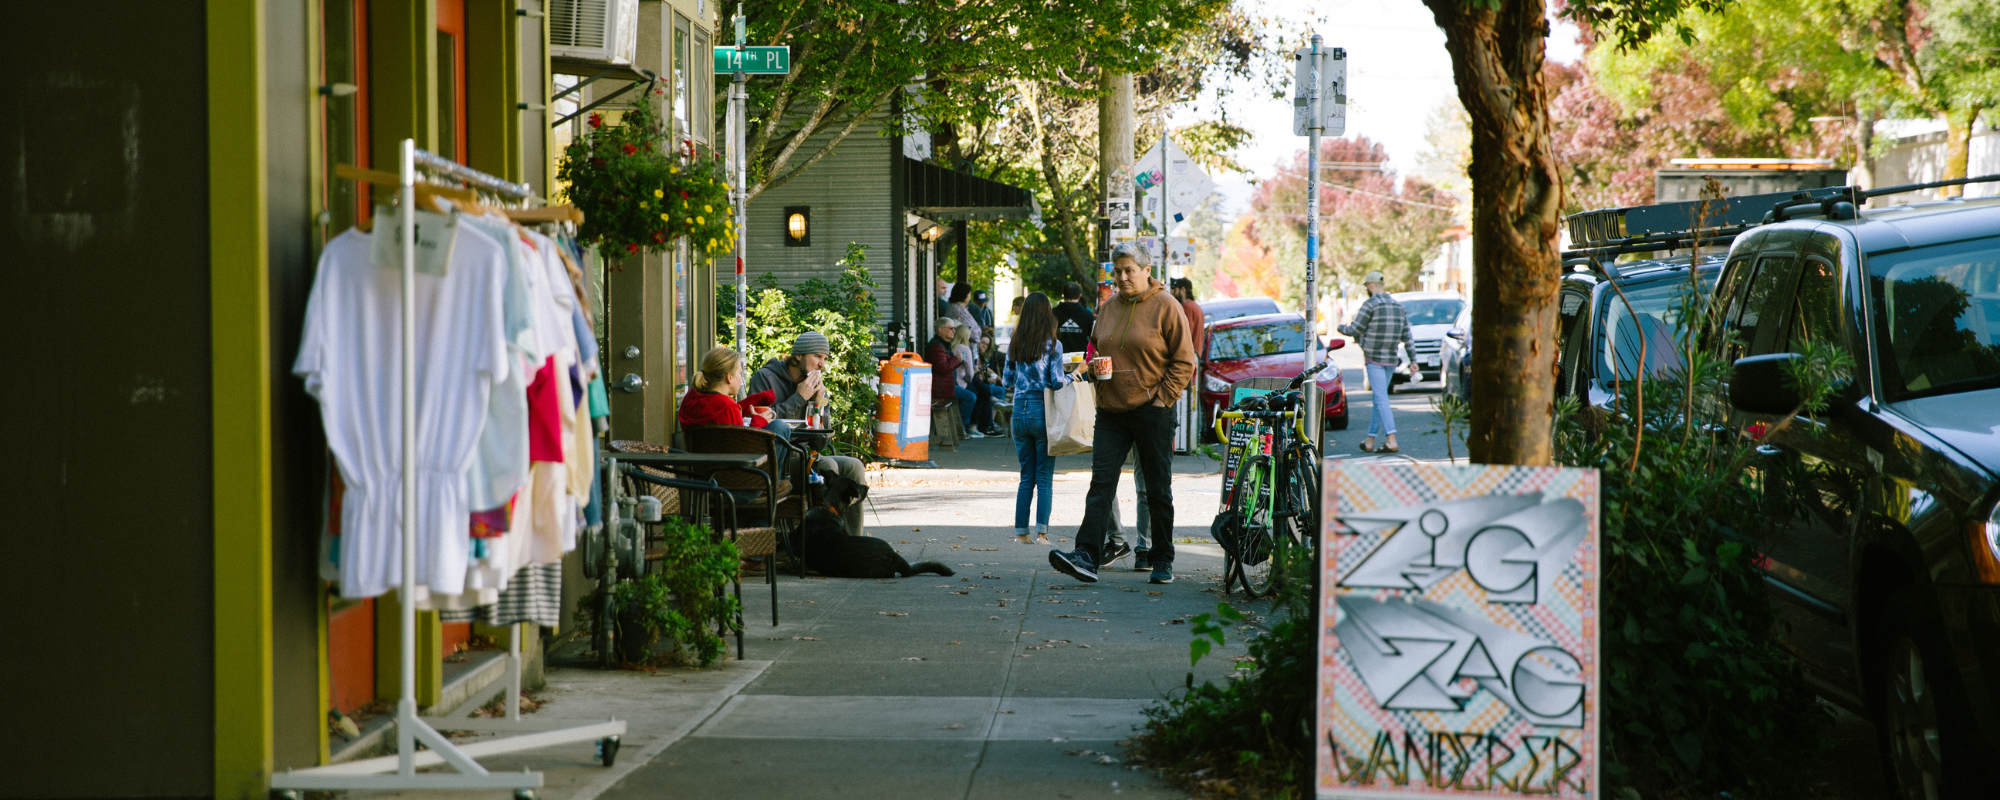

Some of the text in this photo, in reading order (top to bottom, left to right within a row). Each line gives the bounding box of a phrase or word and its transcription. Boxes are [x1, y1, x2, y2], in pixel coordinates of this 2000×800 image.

[766, 51, 783, 69] PL
[1246, 424, 1267, 433] ISITS
[1380, 635, 1585, 729] ZAG
[1328, 729, 1586, 795] WANDERER
